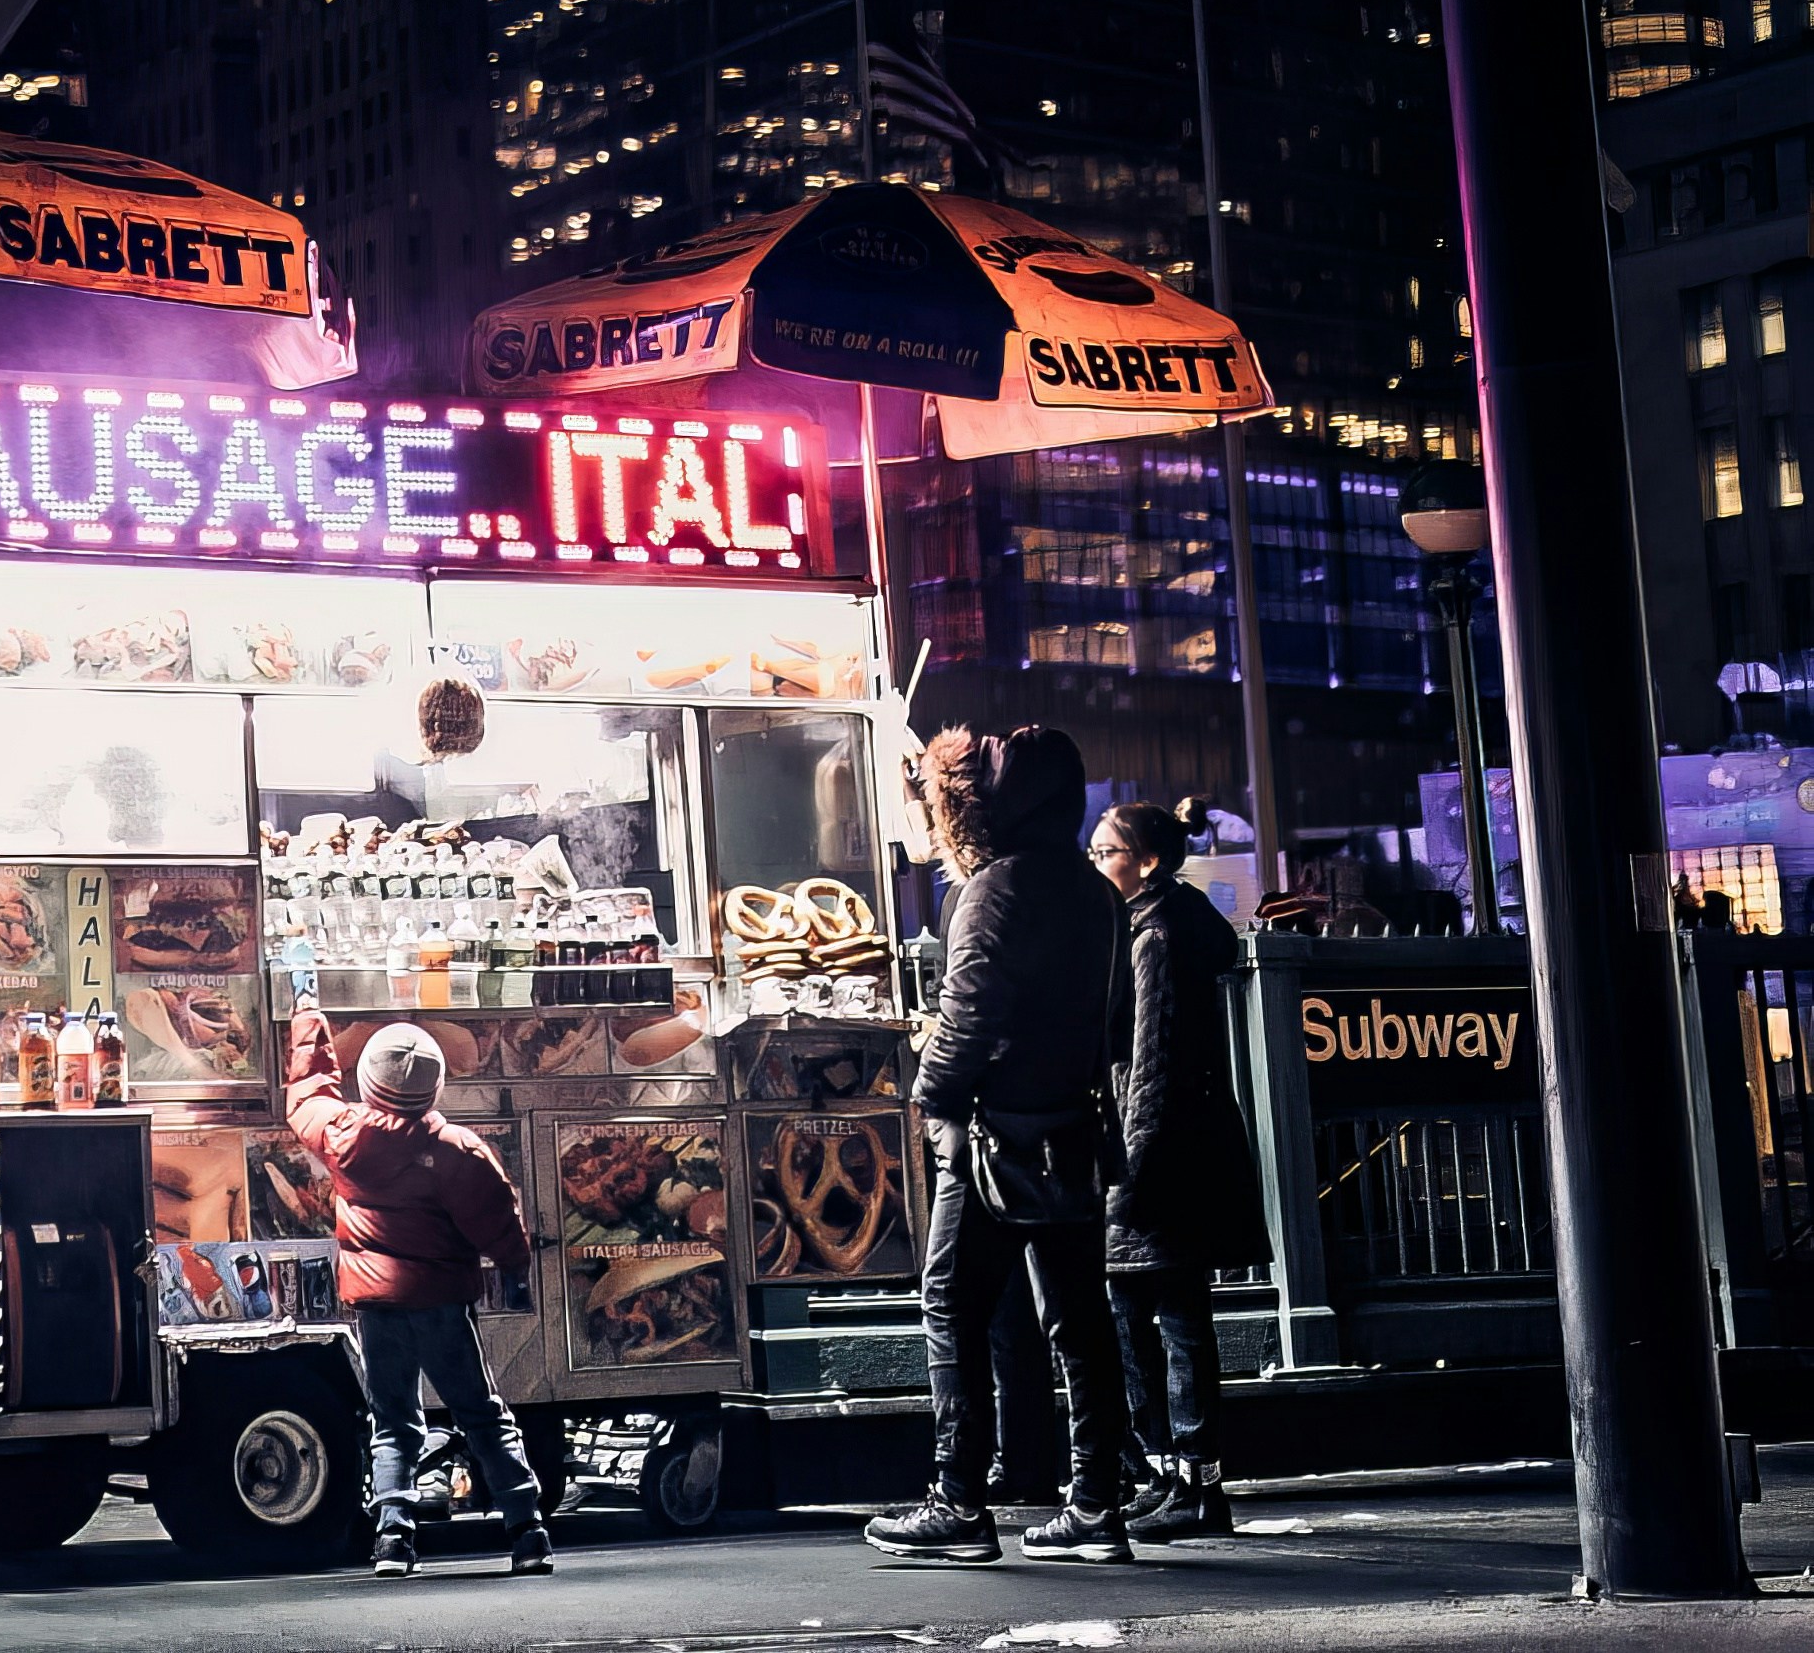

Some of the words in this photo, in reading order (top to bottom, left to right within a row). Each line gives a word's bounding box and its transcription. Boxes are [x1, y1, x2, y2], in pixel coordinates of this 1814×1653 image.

[485, 297, 736, 382] SABRETT
[842, 331, 872, 351] ON
[877, 337, 890, 354] A
[1029, 338, 1238, 394] SABRETT
[1302, 997, 1519, 1071] Subway
[794, 1120, 859, 1135] PRETZEL
[582, 1245, 639, 1259] ITALIAN
[641, 1242, 710, 1257] SAUSAGE
